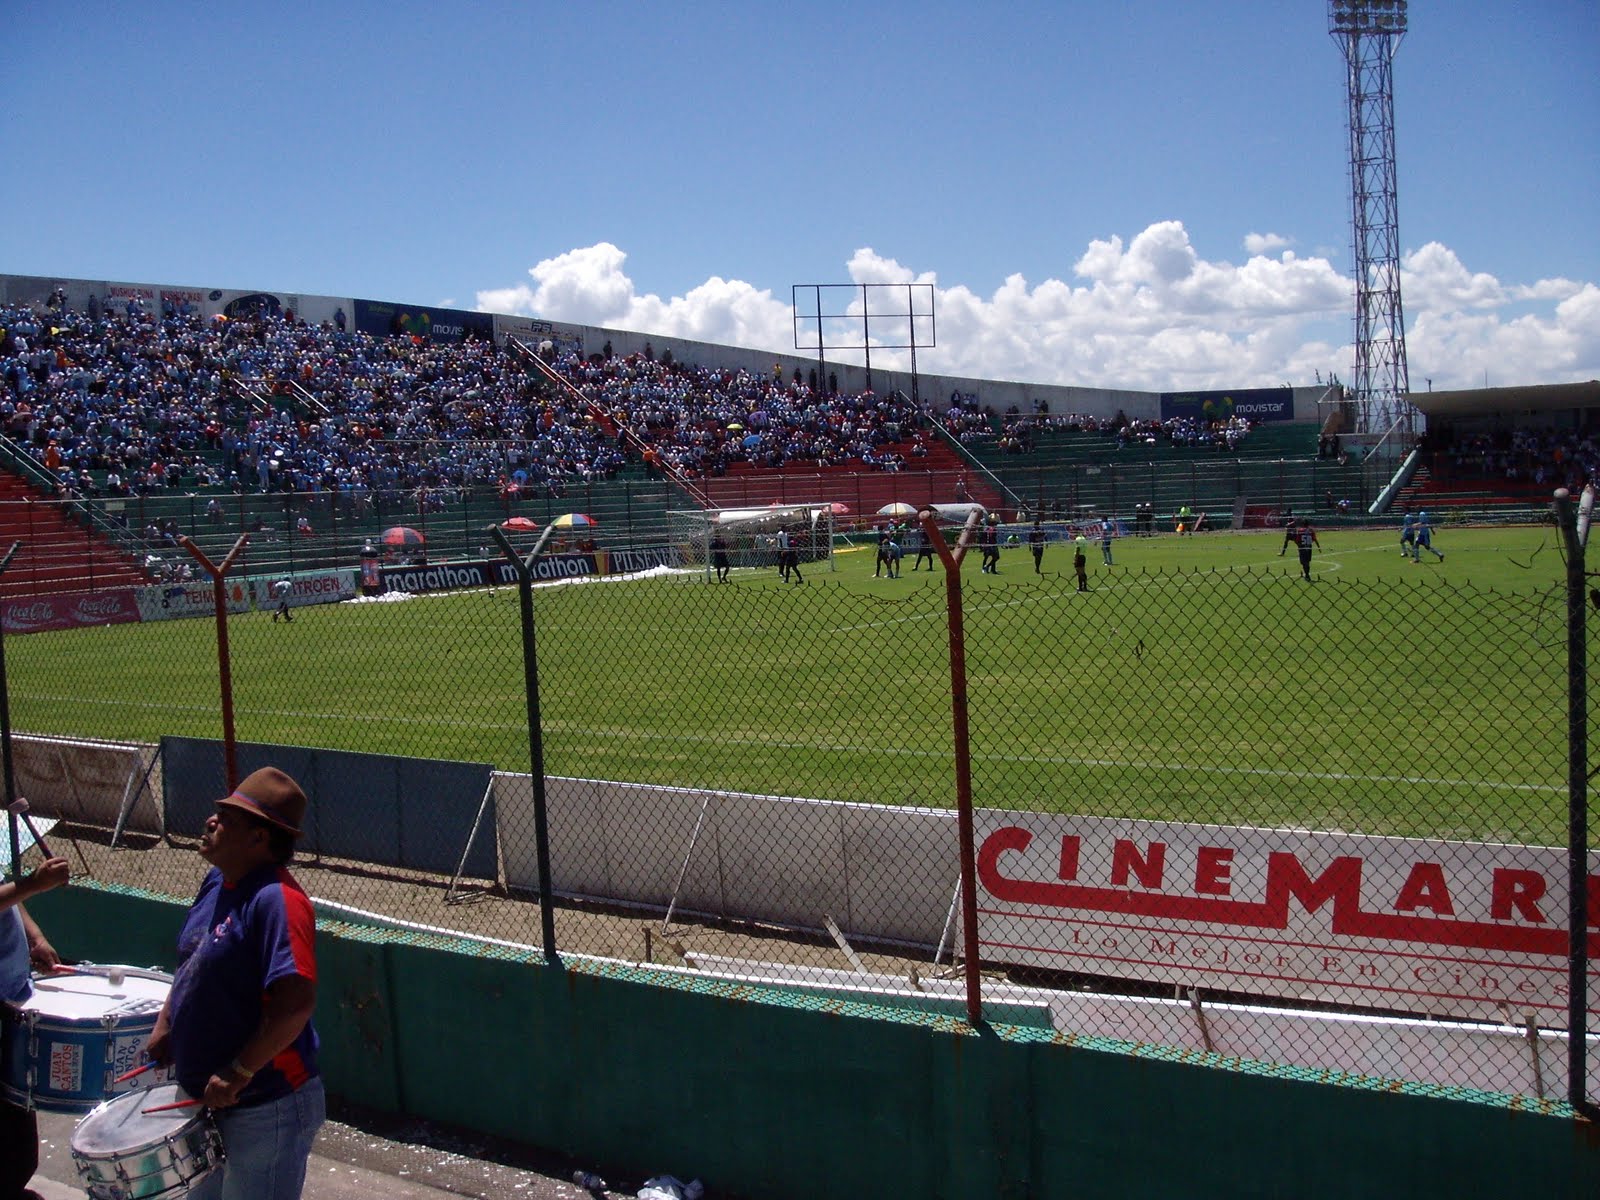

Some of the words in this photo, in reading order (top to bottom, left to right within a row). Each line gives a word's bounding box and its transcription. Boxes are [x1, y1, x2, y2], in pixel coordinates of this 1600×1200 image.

[1236, 402, 1285, 413] movistar
[384, 565, 483, 592] marathon
[500, 556, 590, 582] mrathon
[1072, 929, 1118, 949] Lo
[1150, 938, 1290, 966] Mejor
[1321, 956, 1377, 977] En
[1413, 966, 1569, 996] Cines
[52, 1051, 62, 1082] JUAN
[61, 1045, 72, 1091] CANTOS
[115, 1045, 127, 1076] UAN
[125, 1037, 141, 1087] CNTOS
